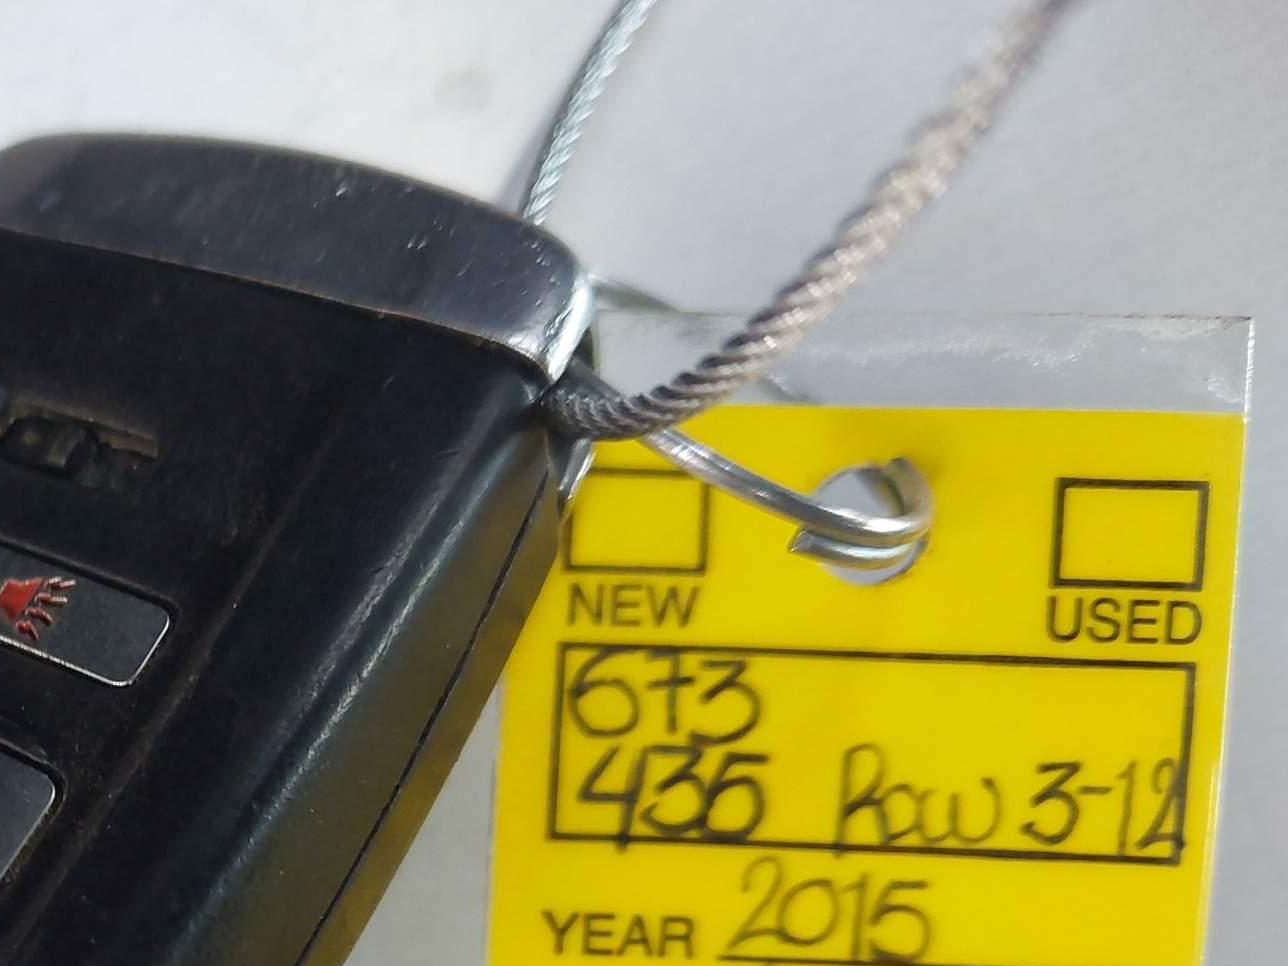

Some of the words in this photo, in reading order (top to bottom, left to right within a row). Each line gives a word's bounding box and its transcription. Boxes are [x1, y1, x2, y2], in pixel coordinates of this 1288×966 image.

[566, 584, 701, 630] NEW
[1046, 597, 1203, 646] USED
[568, 644, 761, 748] 673
[577, 744, 769, 852] 435
[833, 743, 1002, 857] Row
[1020, 757, 1185, 860] 3-12
[543, 910, 696, 959] YEAR
[725, 856, 932, 965] 2015
